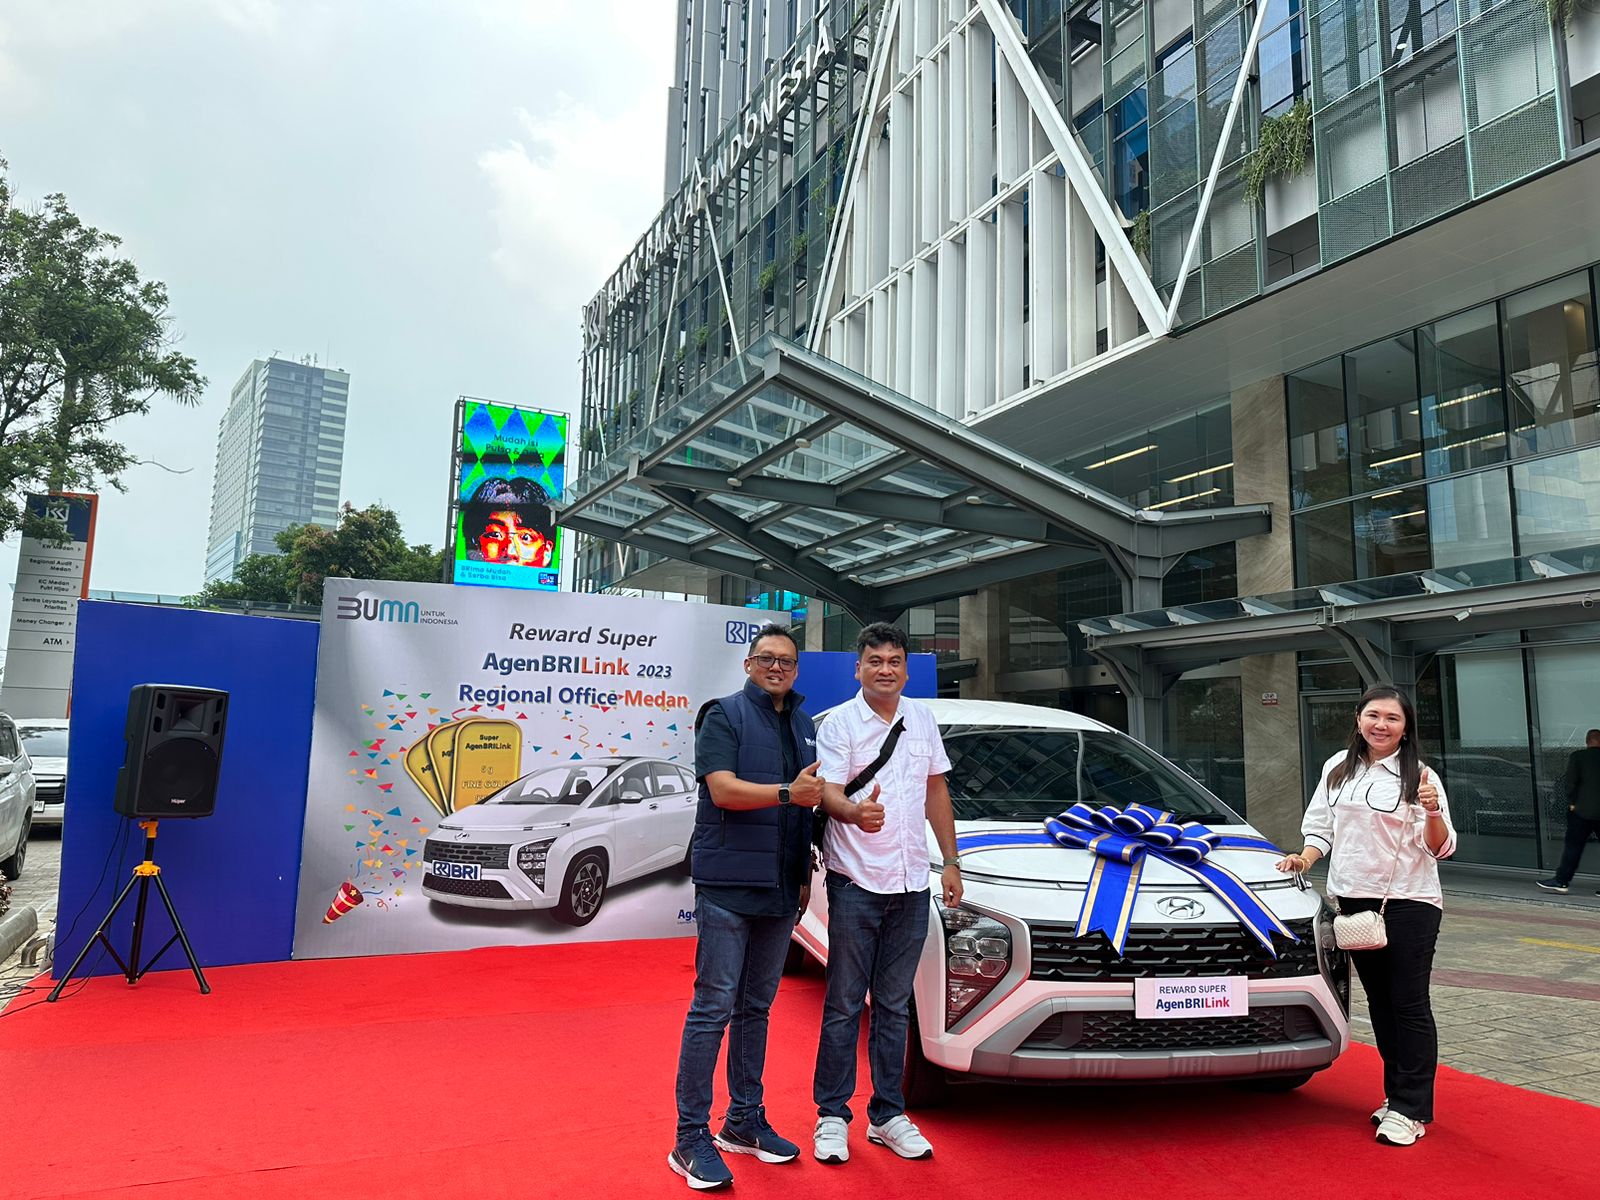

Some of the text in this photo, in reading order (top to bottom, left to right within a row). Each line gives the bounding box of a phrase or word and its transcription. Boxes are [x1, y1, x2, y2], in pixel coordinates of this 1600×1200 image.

[608, 24, 836, 317] BANK RAKYAT INDONESIA
[494, 434, 526, 446] Mudah
[29, 558, 56, 566] Regional
[486, 567, 511, 576] Mudah
[38, 619, 65, 627] Changer
[420, 618, 459, 626] INDONESIA
[509, 622, 657, 650] Reward Super
[43, 638, 63, 646] ATM
[482, 652, 673, 679] AgenBRILink 2023
[459, 684, 689, 708] Regional Office Medan
[465, 743, 512, 751] AgenBRILink
[462, 780, 482, 789] FINE
[451, 864, 478, 879] BRI
[1159, 984, 1227, 994] REWARD SUPER
[1156, 996, 1230, 1012] AgenBRILink
